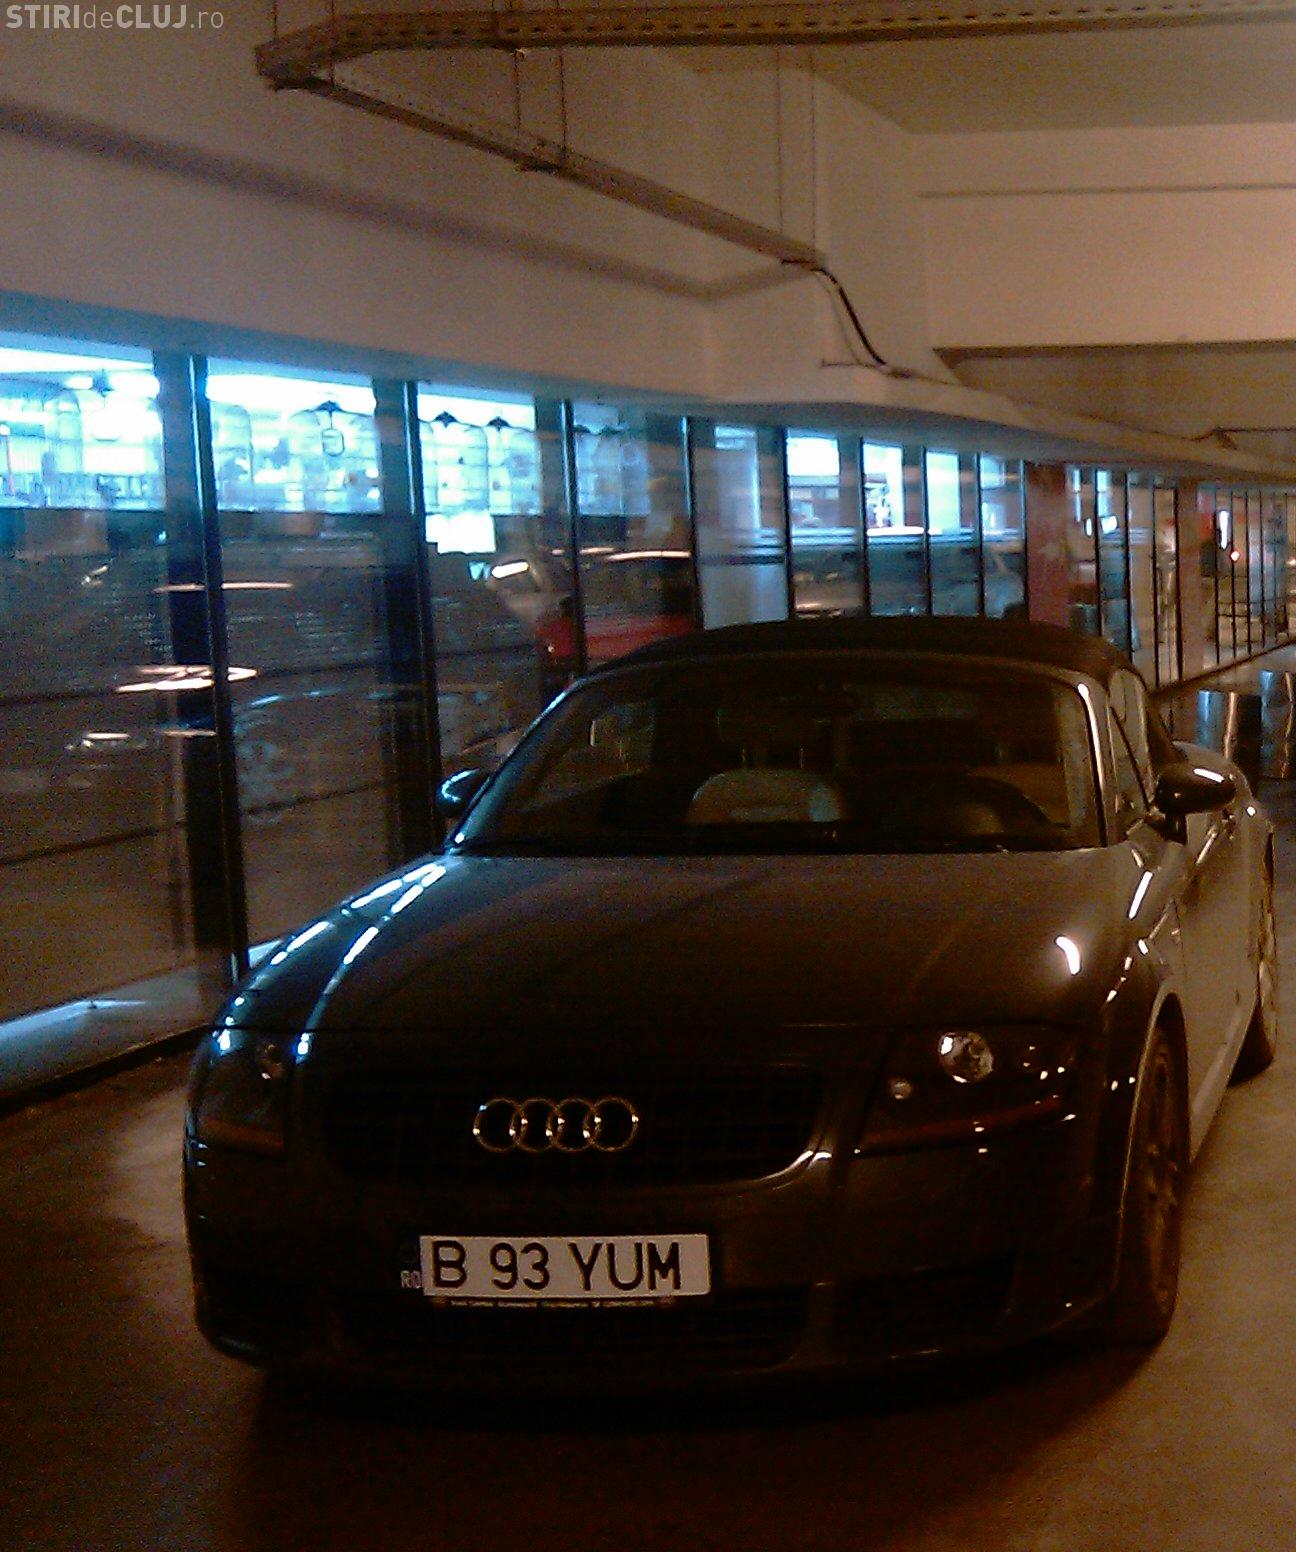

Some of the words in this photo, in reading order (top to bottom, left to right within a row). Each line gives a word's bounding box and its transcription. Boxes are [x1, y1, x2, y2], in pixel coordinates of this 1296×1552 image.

[432, 1240, 467, 1289] B
[490, 1242, 550, 1291] 93
[568, 1241, 682, 1292] YUM
